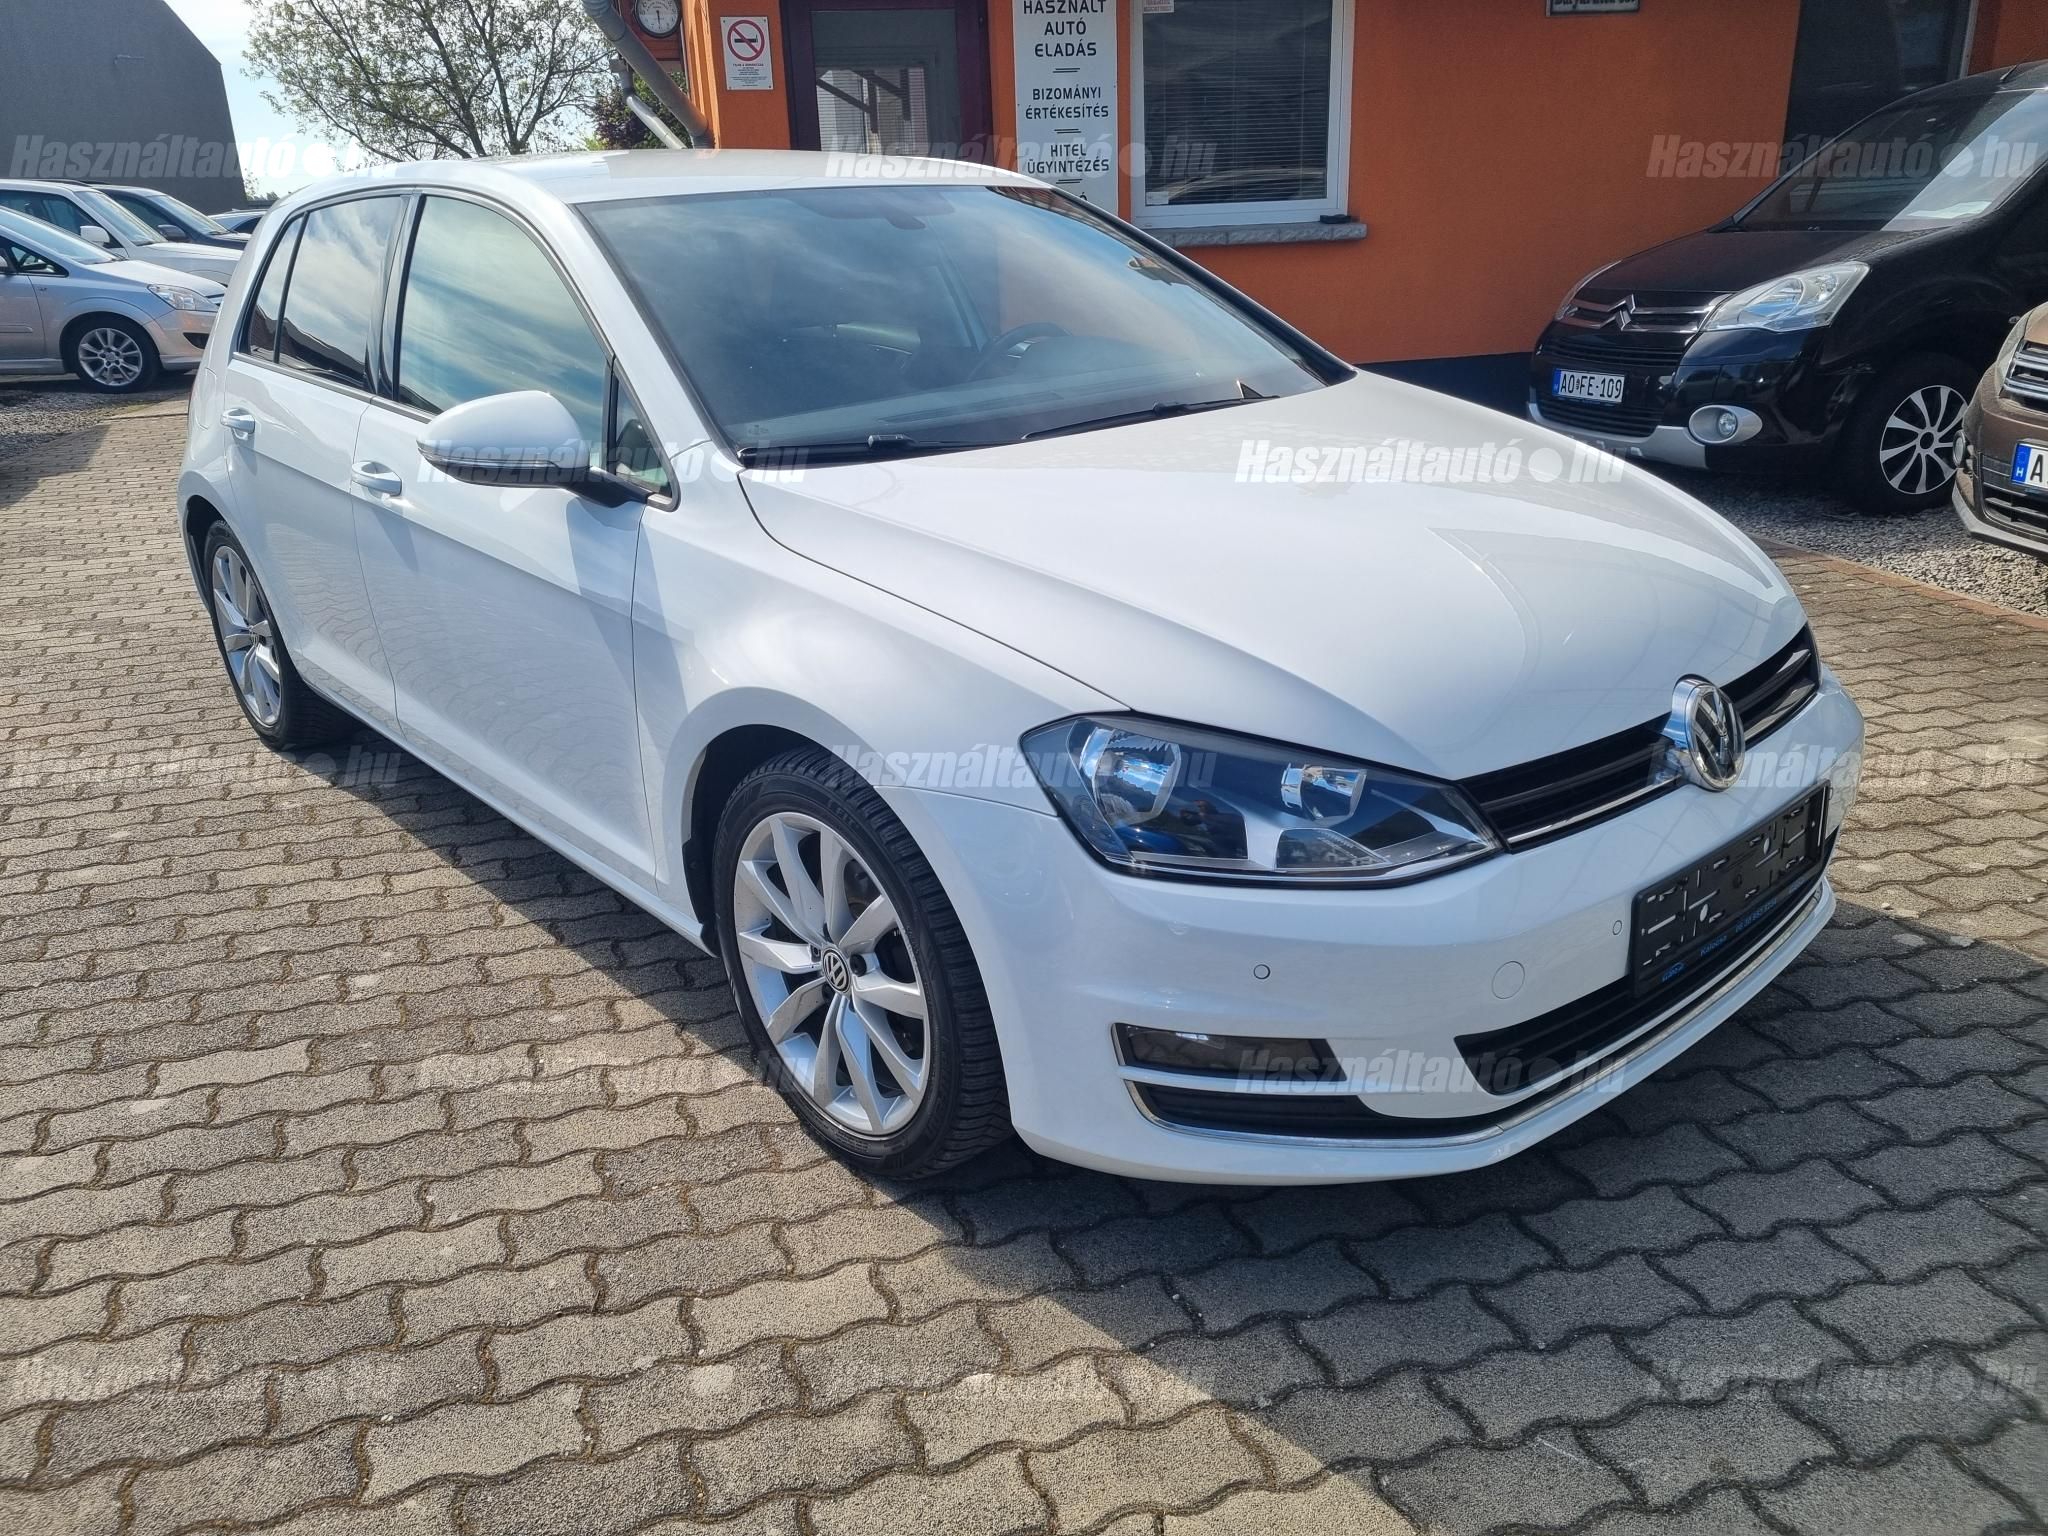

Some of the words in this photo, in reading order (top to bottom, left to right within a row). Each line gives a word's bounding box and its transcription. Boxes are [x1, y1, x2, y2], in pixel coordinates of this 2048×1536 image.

[1044, 17, 1087, 36] AUTÓ
[1034, 39, 1097, 57] ELADÁS
[1032, 84, 1101, 100] BIZOMÁNYI
[1025, 104, 1109, 119] ÉRTÉKESÍTÉS
[1050, 144, 1087, 157] HITEL
[1027, 156, 1110, 174] ÜGYINTÉZÉS
